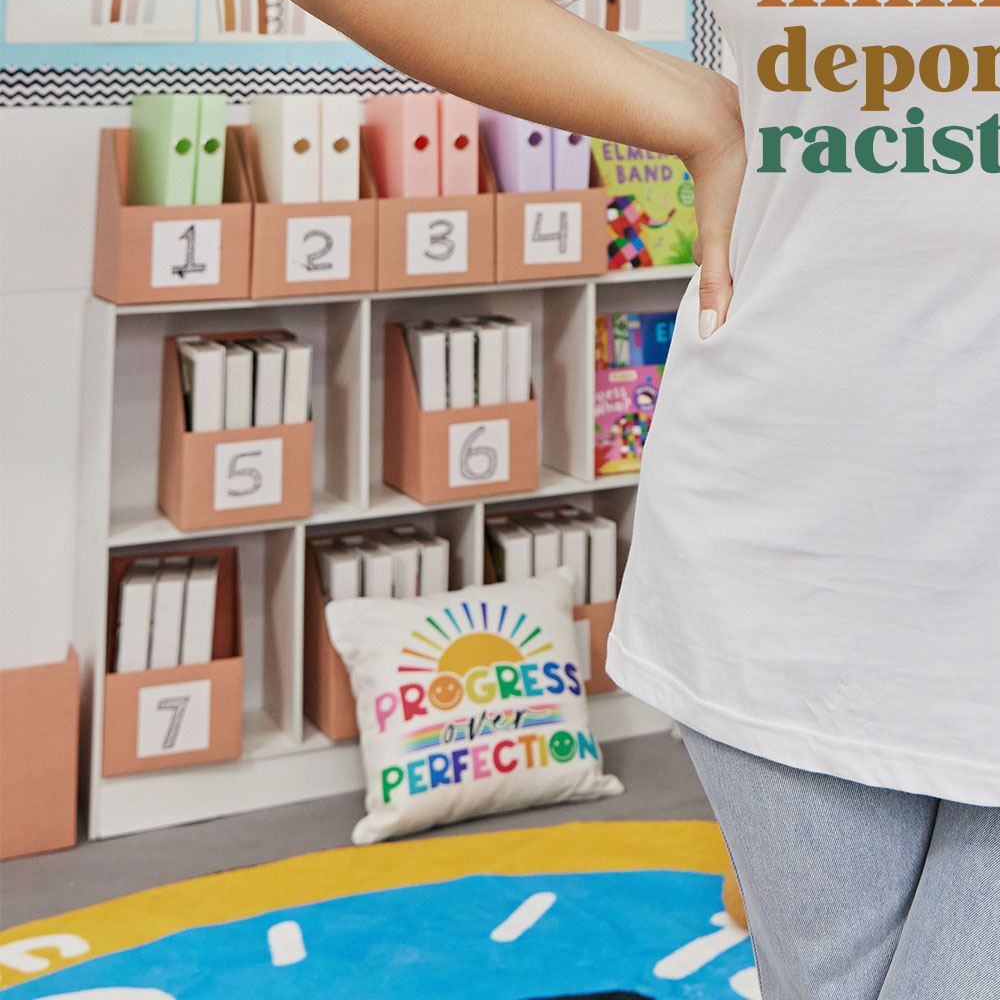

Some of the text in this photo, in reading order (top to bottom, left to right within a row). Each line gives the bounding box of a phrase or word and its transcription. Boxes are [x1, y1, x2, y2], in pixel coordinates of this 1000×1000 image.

[616, 164, 673, 185] BAND
[171, 224, 207, 279] 1
[302, 229, 335, 272] 2
[424, 219, 456, 262] 3
[531, 211, 570, 254] 4
[227, 450, 264, 498] 5
[459, 425, 499, 482] 6
[374, 661, 581, 733] PROGRESS
[155, 696, 192, 753] 7
[443, 709, 528, 744] over
[381, 730, 599, 804] PERFECTION
